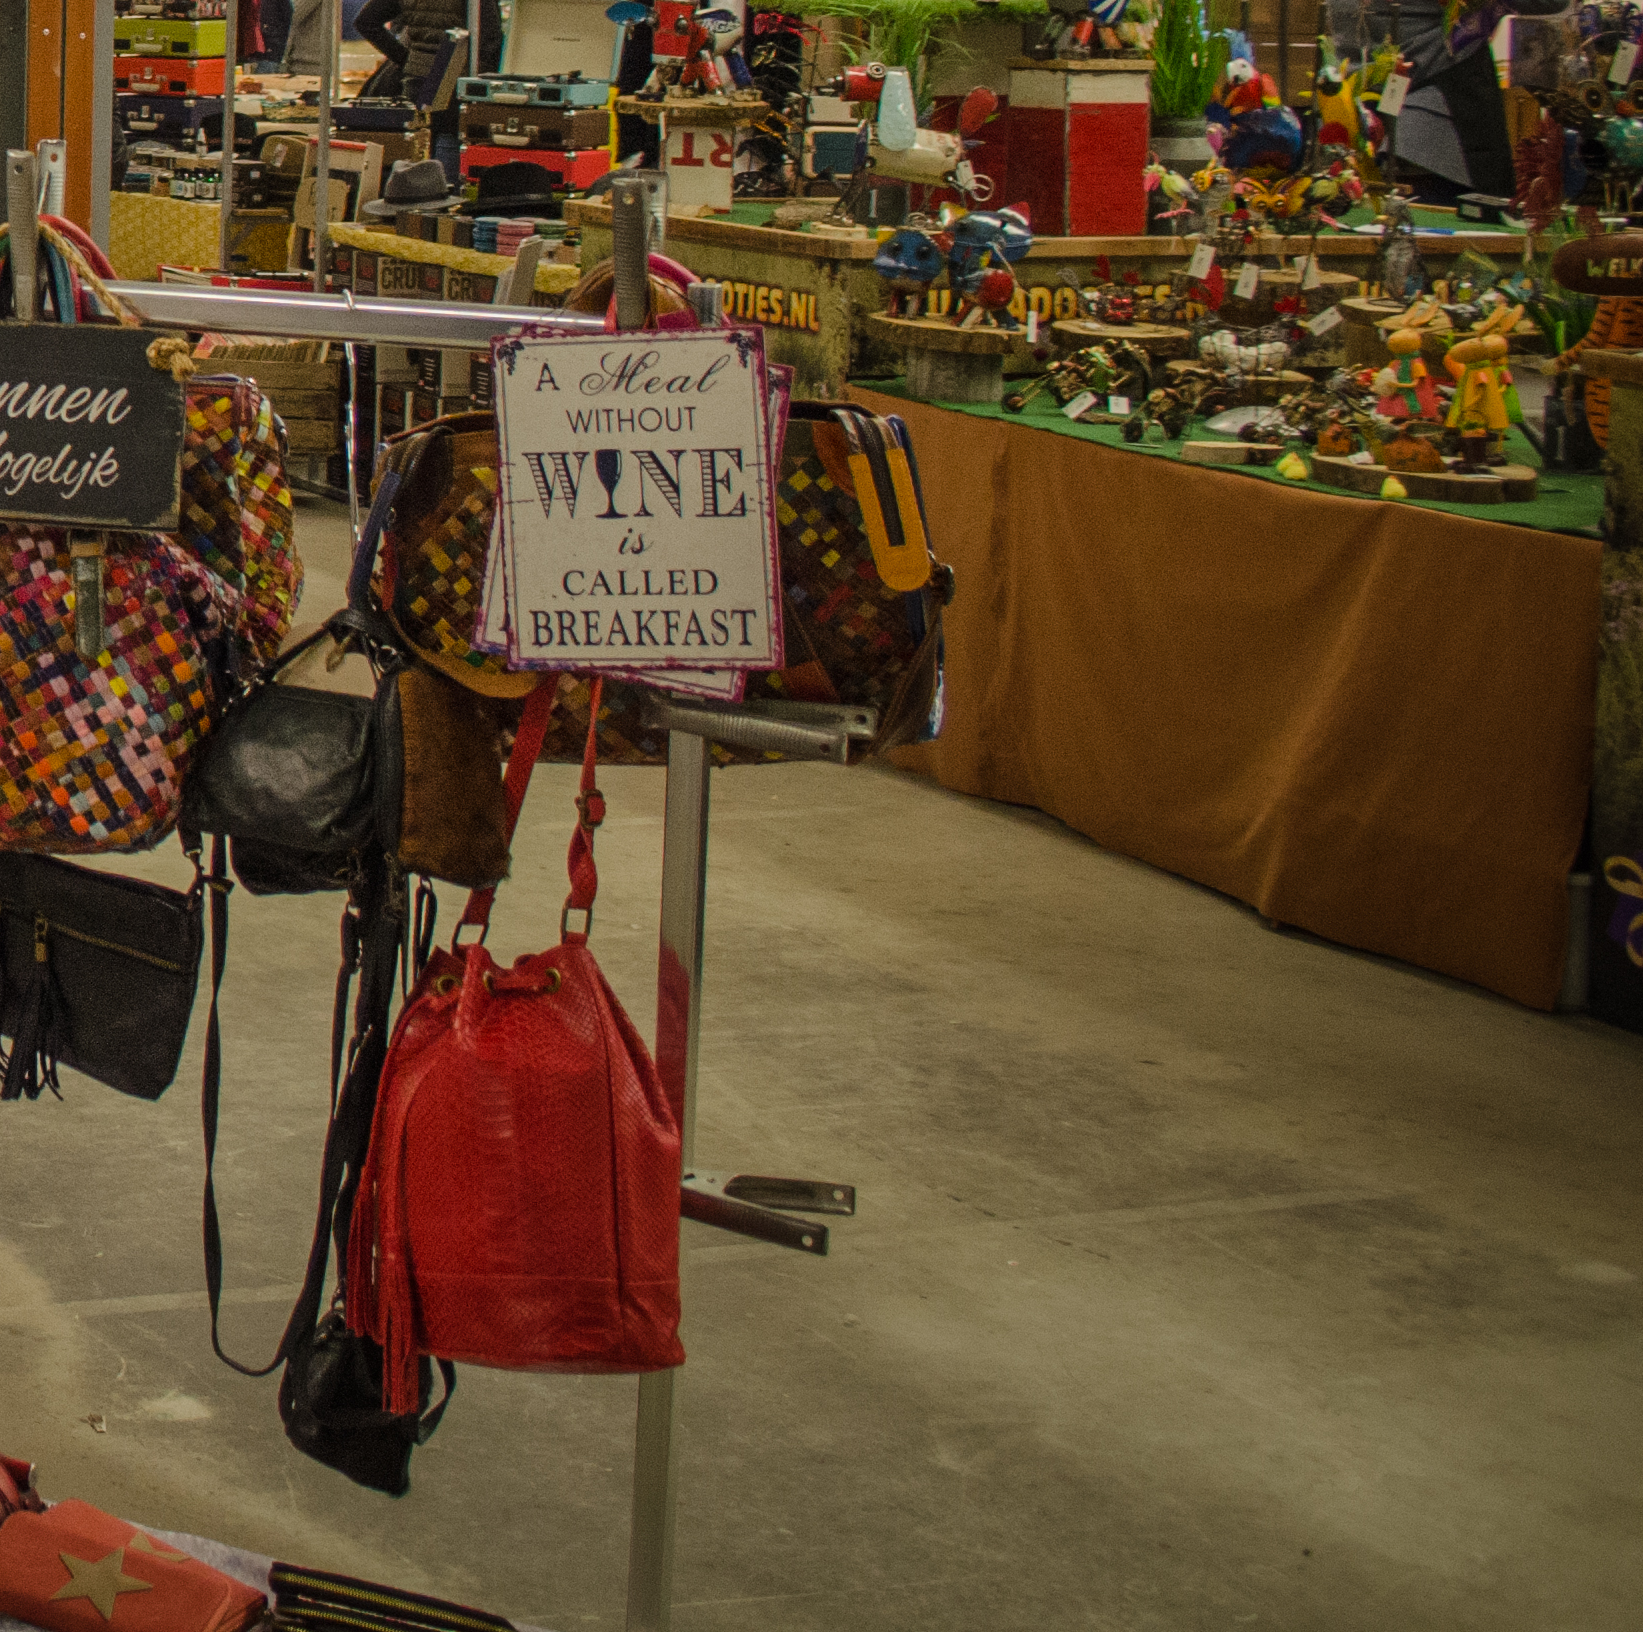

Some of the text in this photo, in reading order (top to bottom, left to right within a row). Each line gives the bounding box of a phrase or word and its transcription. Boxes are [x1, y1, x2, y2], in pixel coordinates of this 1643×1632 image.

[706, 278, 820, 332] OTJES.NL
[535, 350, 731, 397] A Meal
[566, 406, 697, 434] WITHOUT
[618, 528, 654, 556] is
[561, 569, 719, 597] CALLED
[528, 609, 758, 647] BREAKFAST
